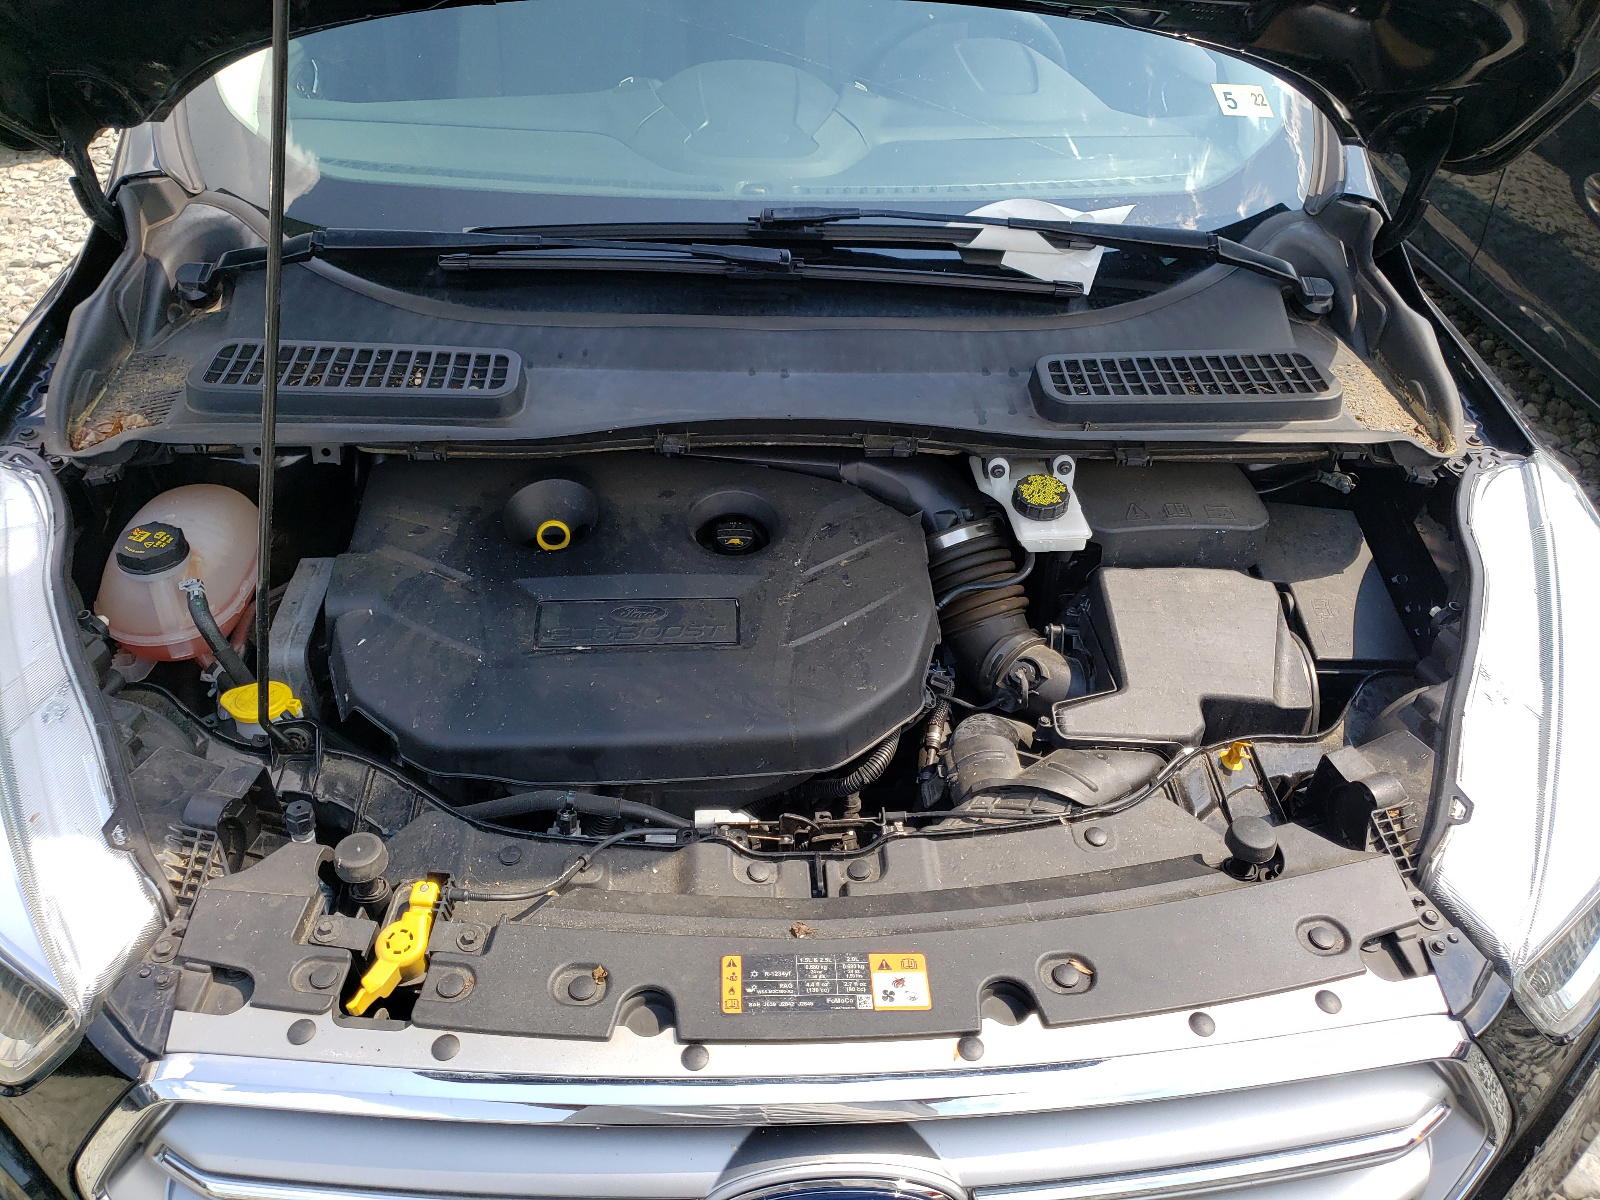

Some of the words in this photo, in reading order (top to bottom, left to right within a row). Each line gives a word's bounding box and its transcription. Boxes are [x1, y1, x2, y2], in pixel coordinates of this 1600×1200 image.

[1222, 91, 1238, 110] 5
[1250, 92, 1268, 107] 22
[764, 970, 791, 978] R-1234yf
